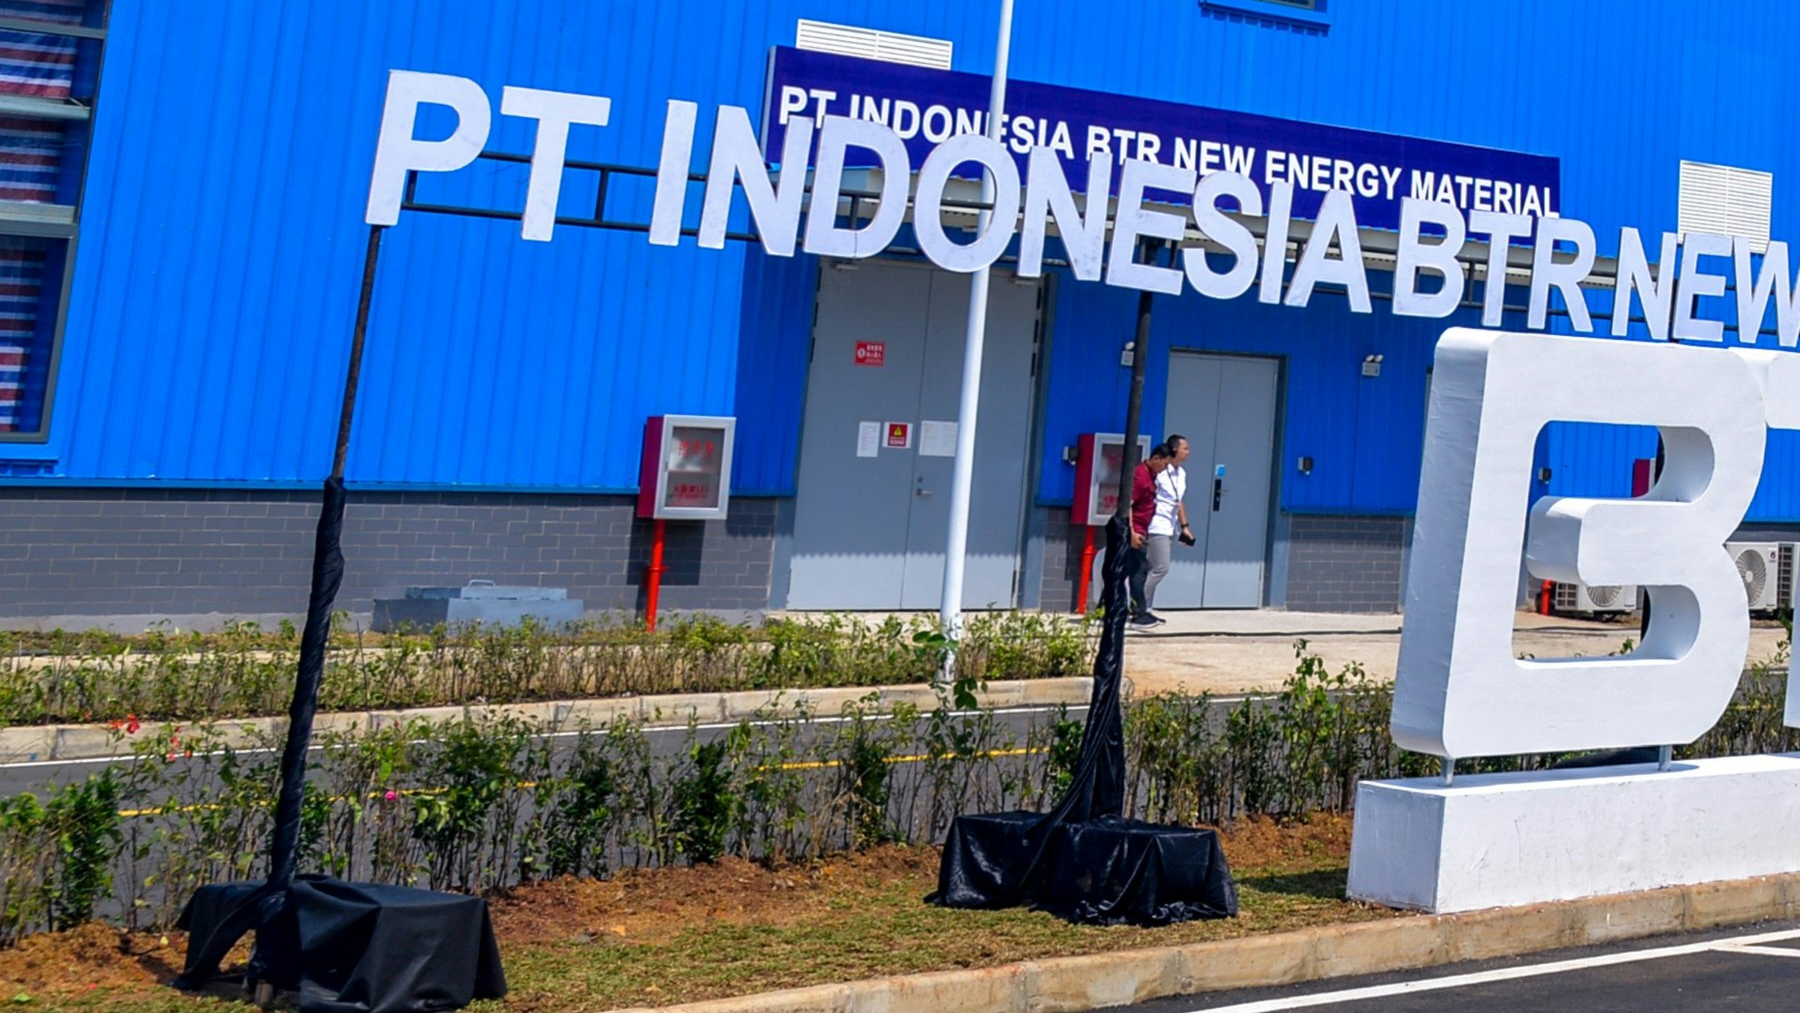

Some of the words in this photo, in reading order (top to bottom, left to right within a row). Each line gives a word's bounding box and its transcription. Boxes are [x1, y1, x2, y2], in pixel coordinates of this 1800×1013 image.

[365, 69, 611, 242] PT
[648, 99, 1373, 314] INDONESIA
[1392, 196, 1597, 333] BTR
[778, 85, 837, 129] PT
[1085, 124, 1162, 166] BTR
[1173, 136, 1256, 179] NEW
[1265, 149, 1403, 201] ENERGY
[1409, 166, 1560, 219] MATERIAL
